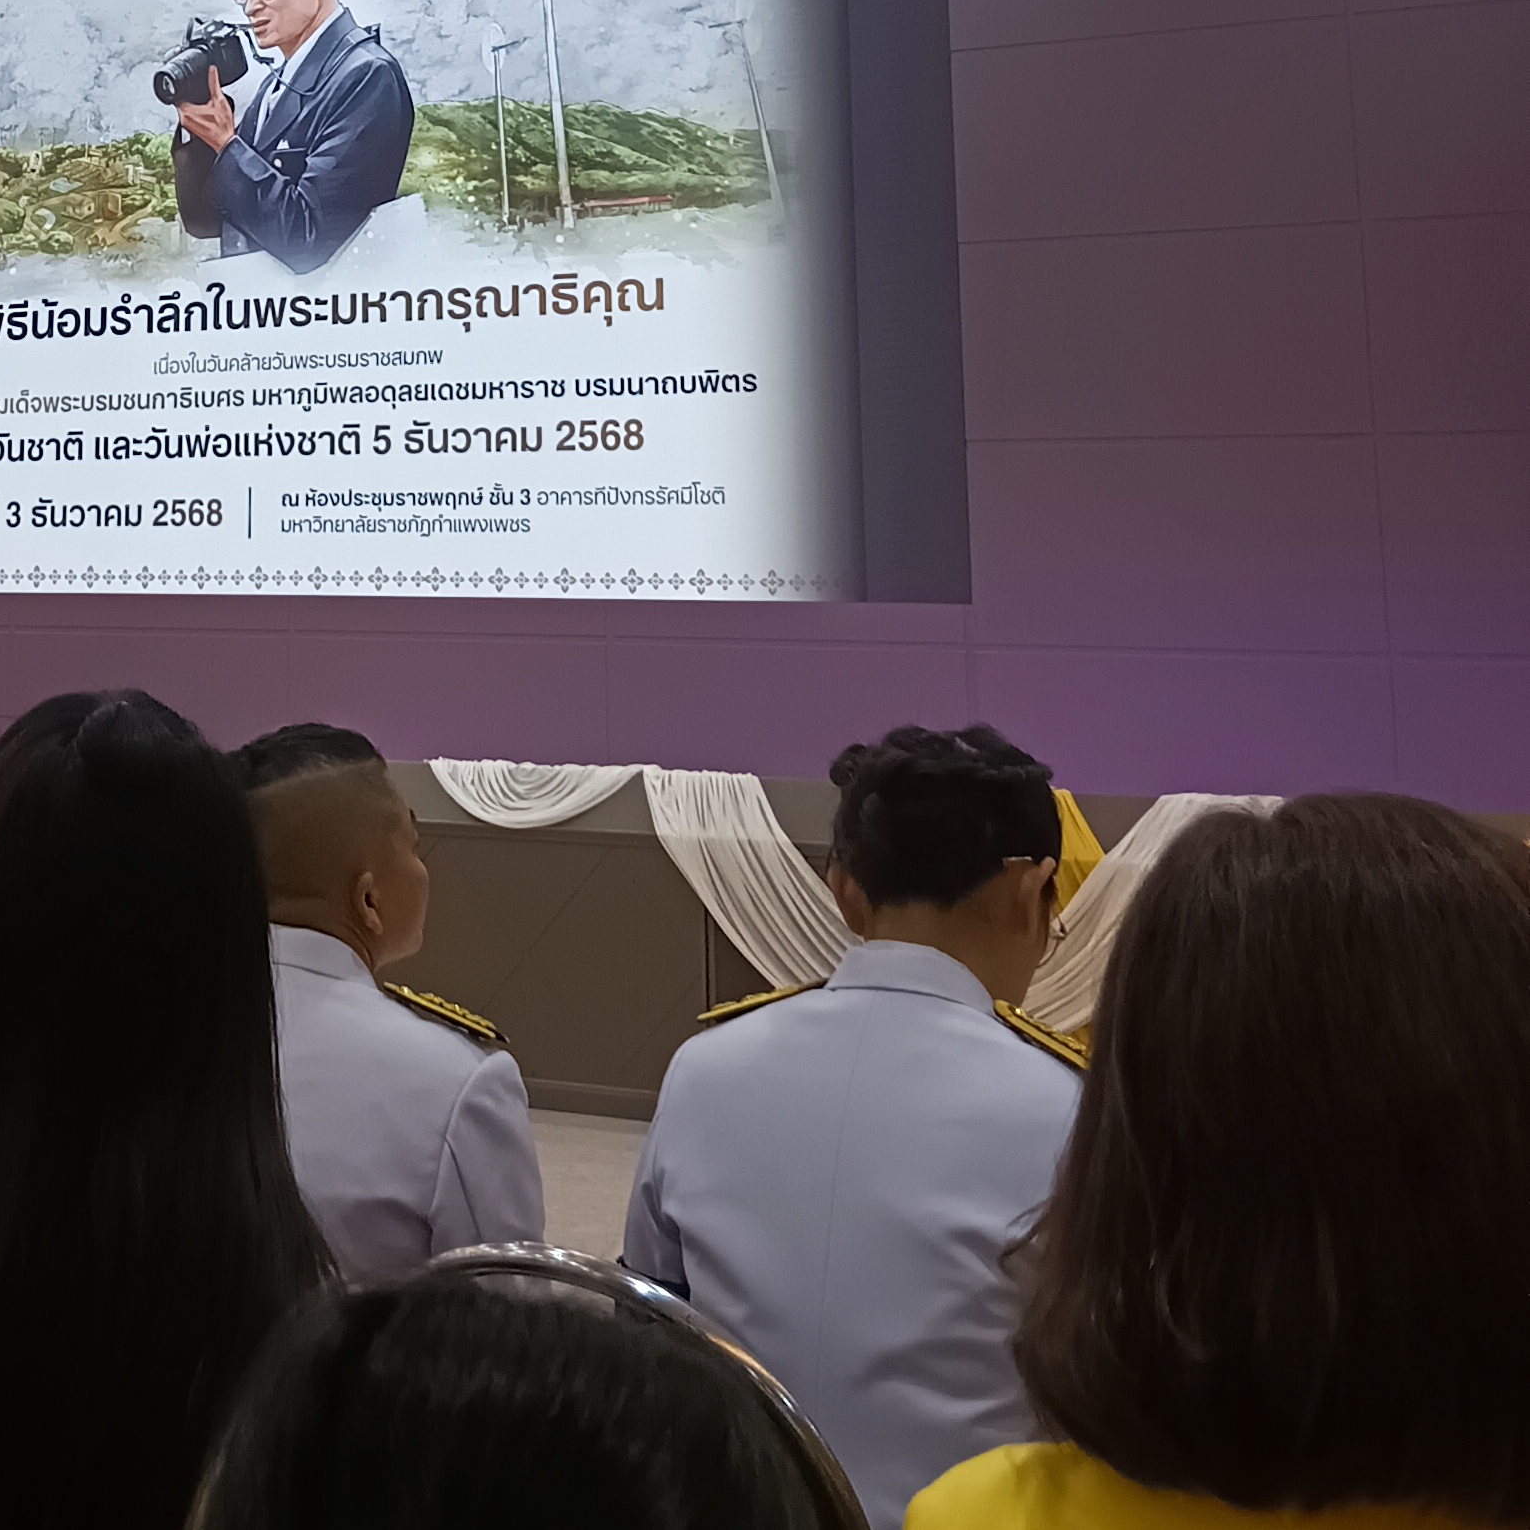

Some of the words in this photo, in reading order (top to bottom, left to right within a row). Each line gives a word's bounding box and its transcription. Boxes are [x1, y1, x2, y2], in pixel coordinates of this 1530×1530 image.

[153, 347, 444, 377] เนื่องในวันคล้ายวันพระบรมราชสมภพ
[251, 379, 567, 413] มหาภูมิพลอดุลยเดชมหาราช
[574, 368, 759, 399] บรมนาถบพิตร
[93, 422, 363, 462] และวันพ่อแห่งชาติ
[372, 424, 393, 456] 5
[402, 419, 544, 455] ธันวาคม
[555, 418, 646, 453] 2568
[5, 500, 23, 530] 3
[30, 496, 144, 529] ธันวาคม
[151, 498, 225, 528] 2568
[280, 492, 301, 509] ณ
[304, 486, 485, 513] ห้องประชุมราชพฤกษ์
[488, 482, 515, 507] ชั้น
[519, 487, 532, 507] 3
